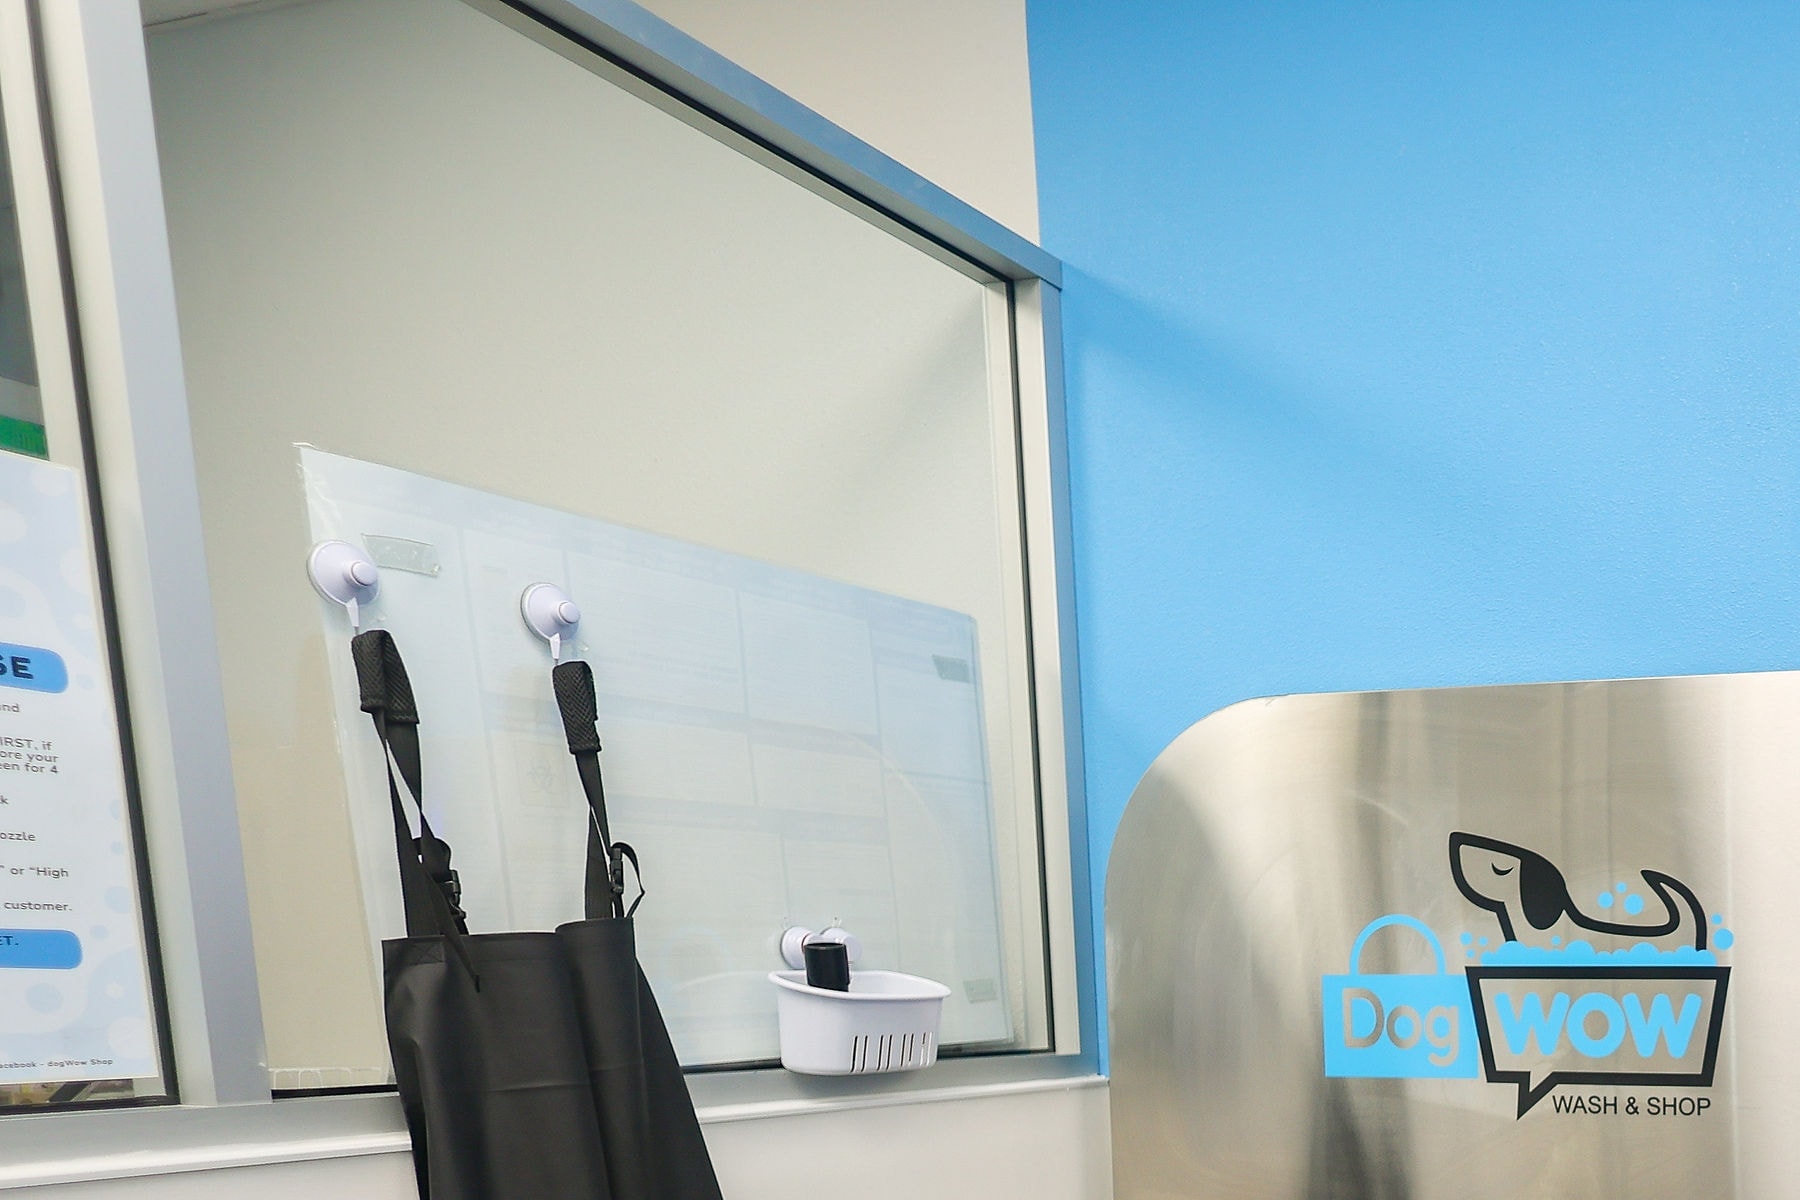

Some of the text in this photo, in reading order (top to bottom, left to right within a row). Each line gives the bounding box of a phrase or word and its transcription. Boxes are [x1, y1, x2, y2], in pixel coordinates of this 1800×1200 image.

[42, 741, 52, 751] if
[26, 753, 59, 763] your
[25, 763, 45, 773] for
[50, 765, 58, 774] 4
[10, 867, 25, 875] or
[4, 901, 73, 911] customer.
[1342, 987, 1458, 1067] Dog
[1493, 991, 1702, 1059] WOW
[1552, 1095, 1711, 1116] WASH & SHOP
